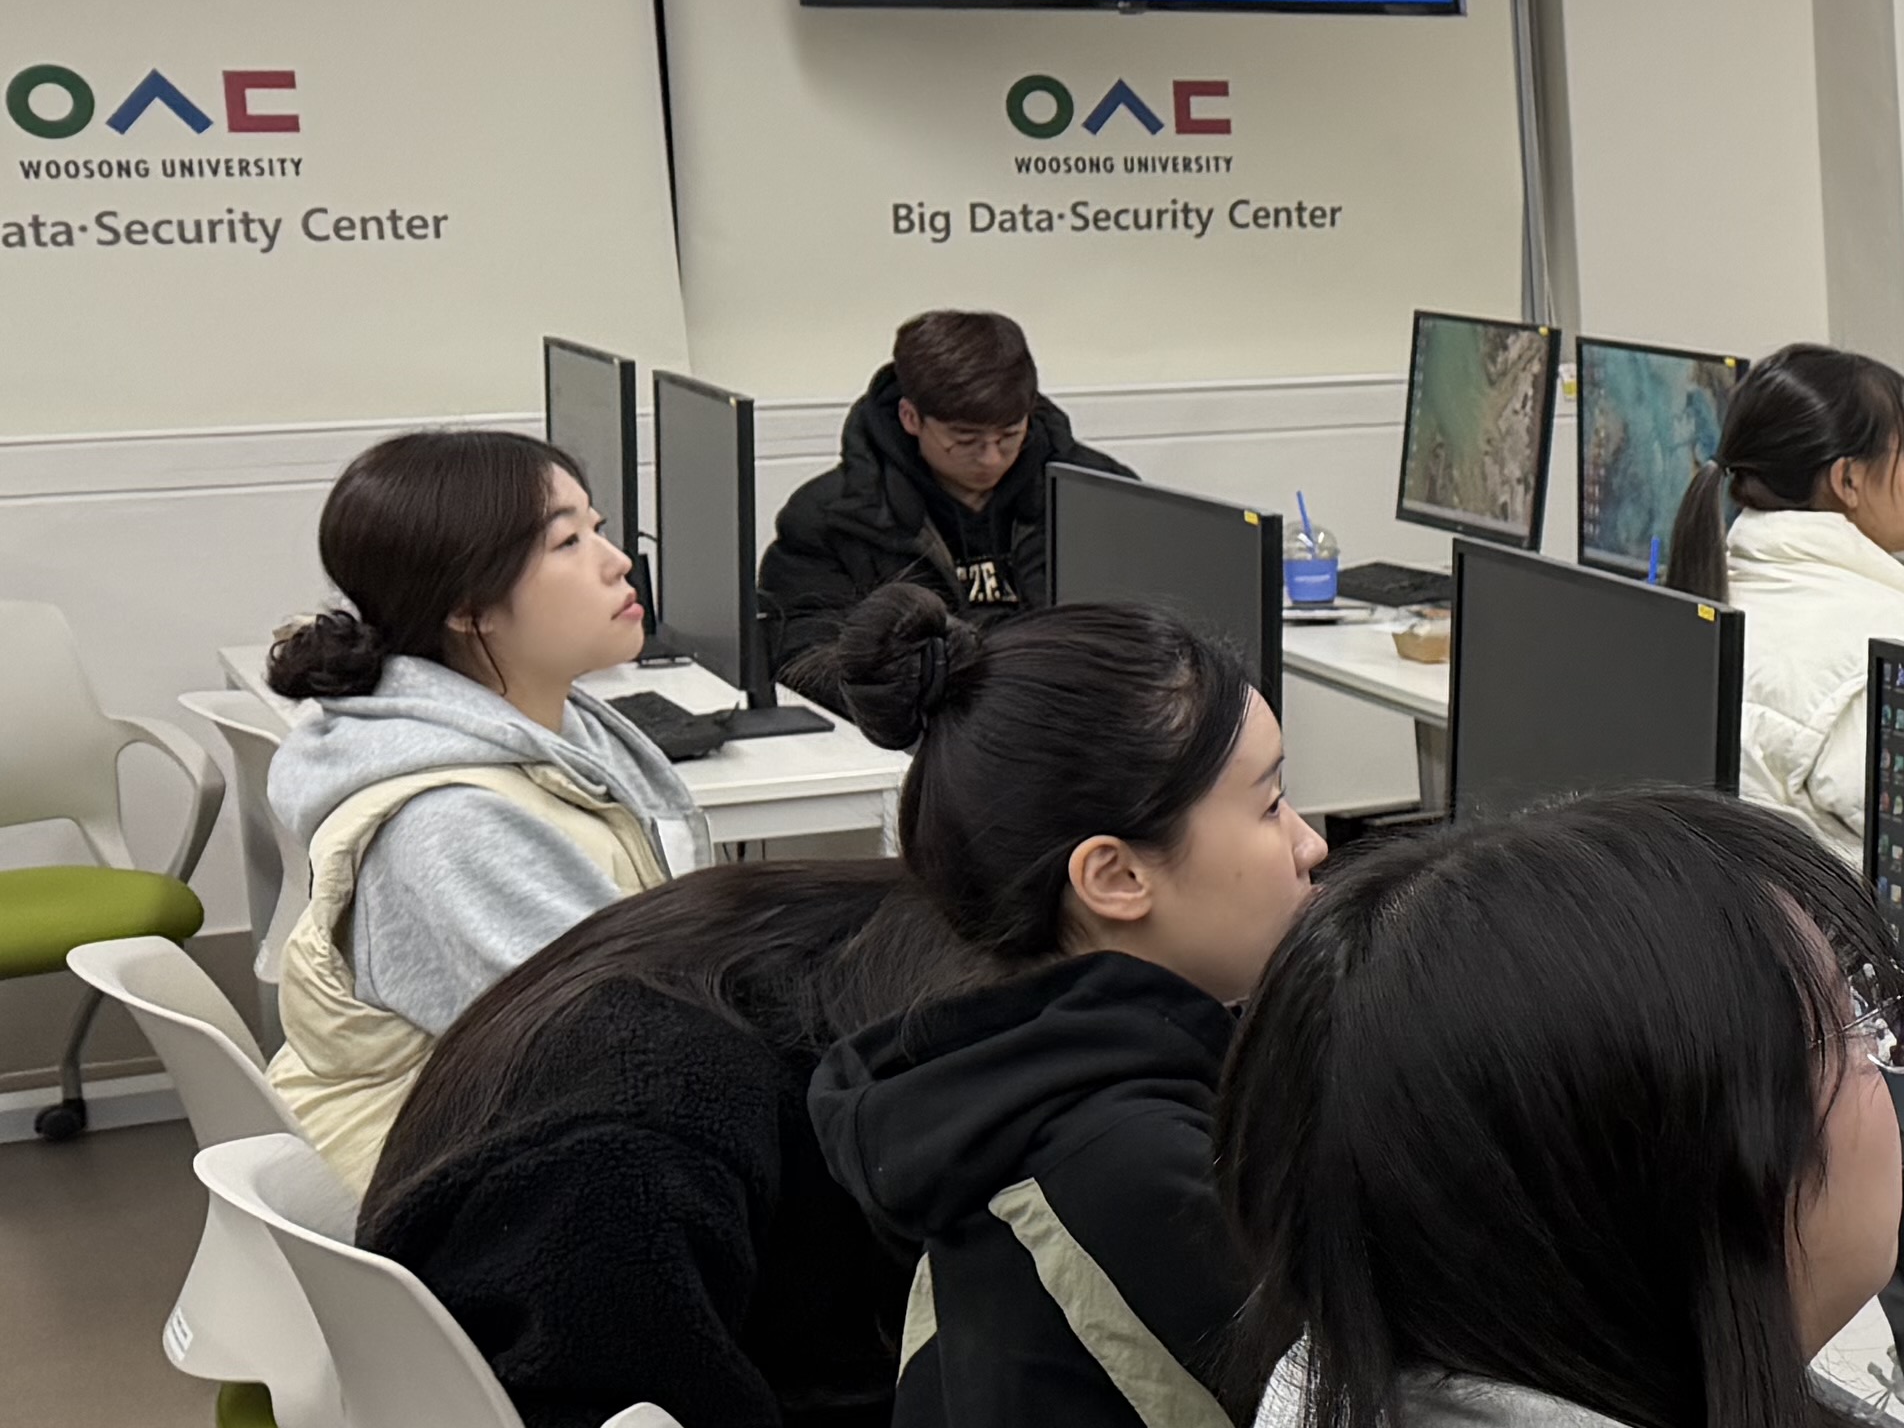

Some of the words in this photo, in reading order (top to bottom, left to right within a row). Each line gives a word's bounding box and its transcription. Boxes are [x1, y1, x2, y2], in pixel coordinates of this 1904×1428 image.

[20, 160, 150, 179] WOOSONG
[162, 158, 302, 178] UNIVERSITY
[1015, 157, 1115, 174] WOOSONG
[1124, 156, 1232, 173] UNIVERSITY
[2, 208, 282, 254] ata·Security
[302, 208, 449, 242] Center
[893, 202, 951, 243] Big
[1229, 199, 1342, 229] Center
